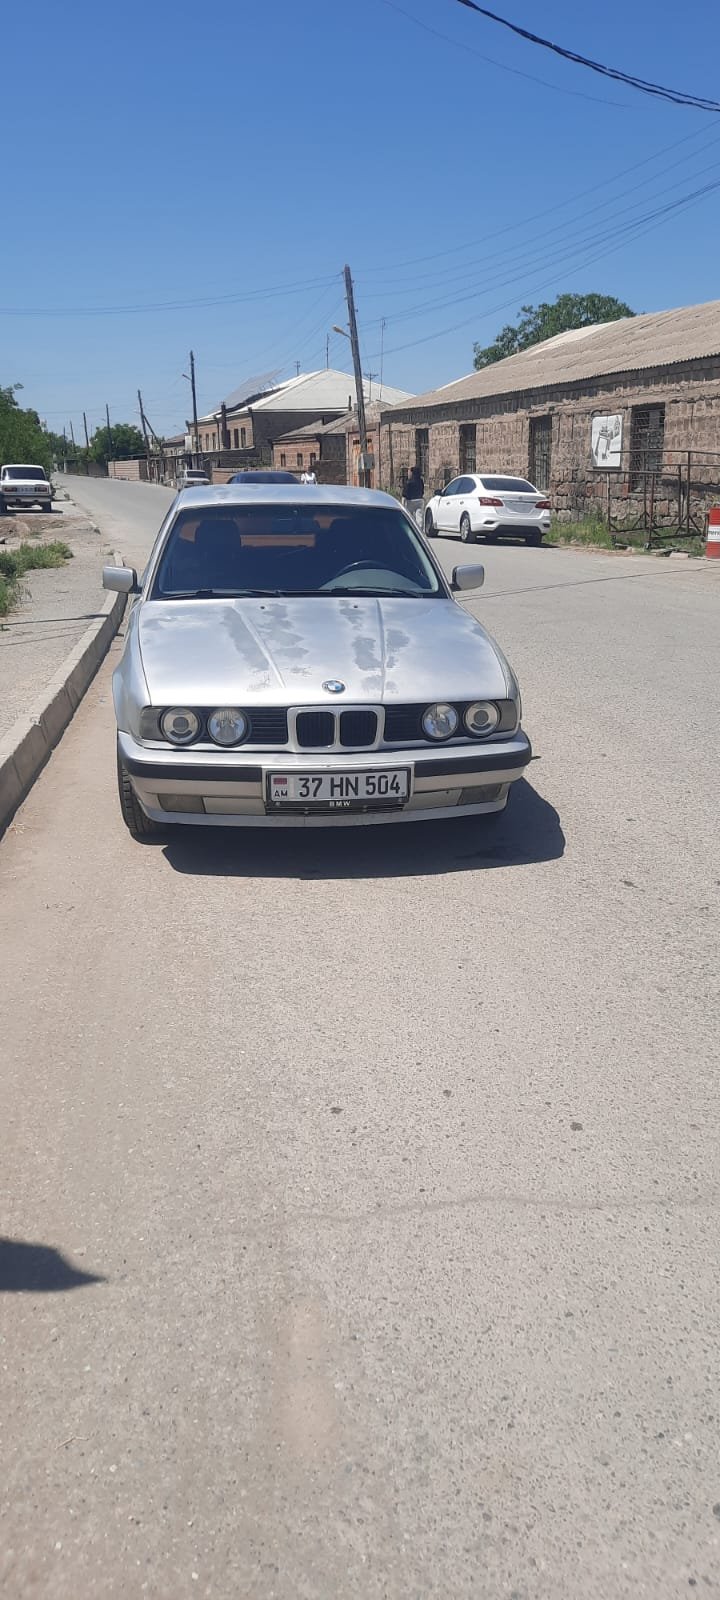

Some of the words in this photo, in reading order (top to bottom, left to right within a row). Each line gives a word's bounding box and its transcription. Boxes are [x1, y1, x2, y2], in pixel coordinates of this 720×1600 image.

[274, 789, 288, 798] AM
[298, 777, 323, 798] 37
[330, 776, 359, 797] HN
[365, 774, 401, 796] 504
